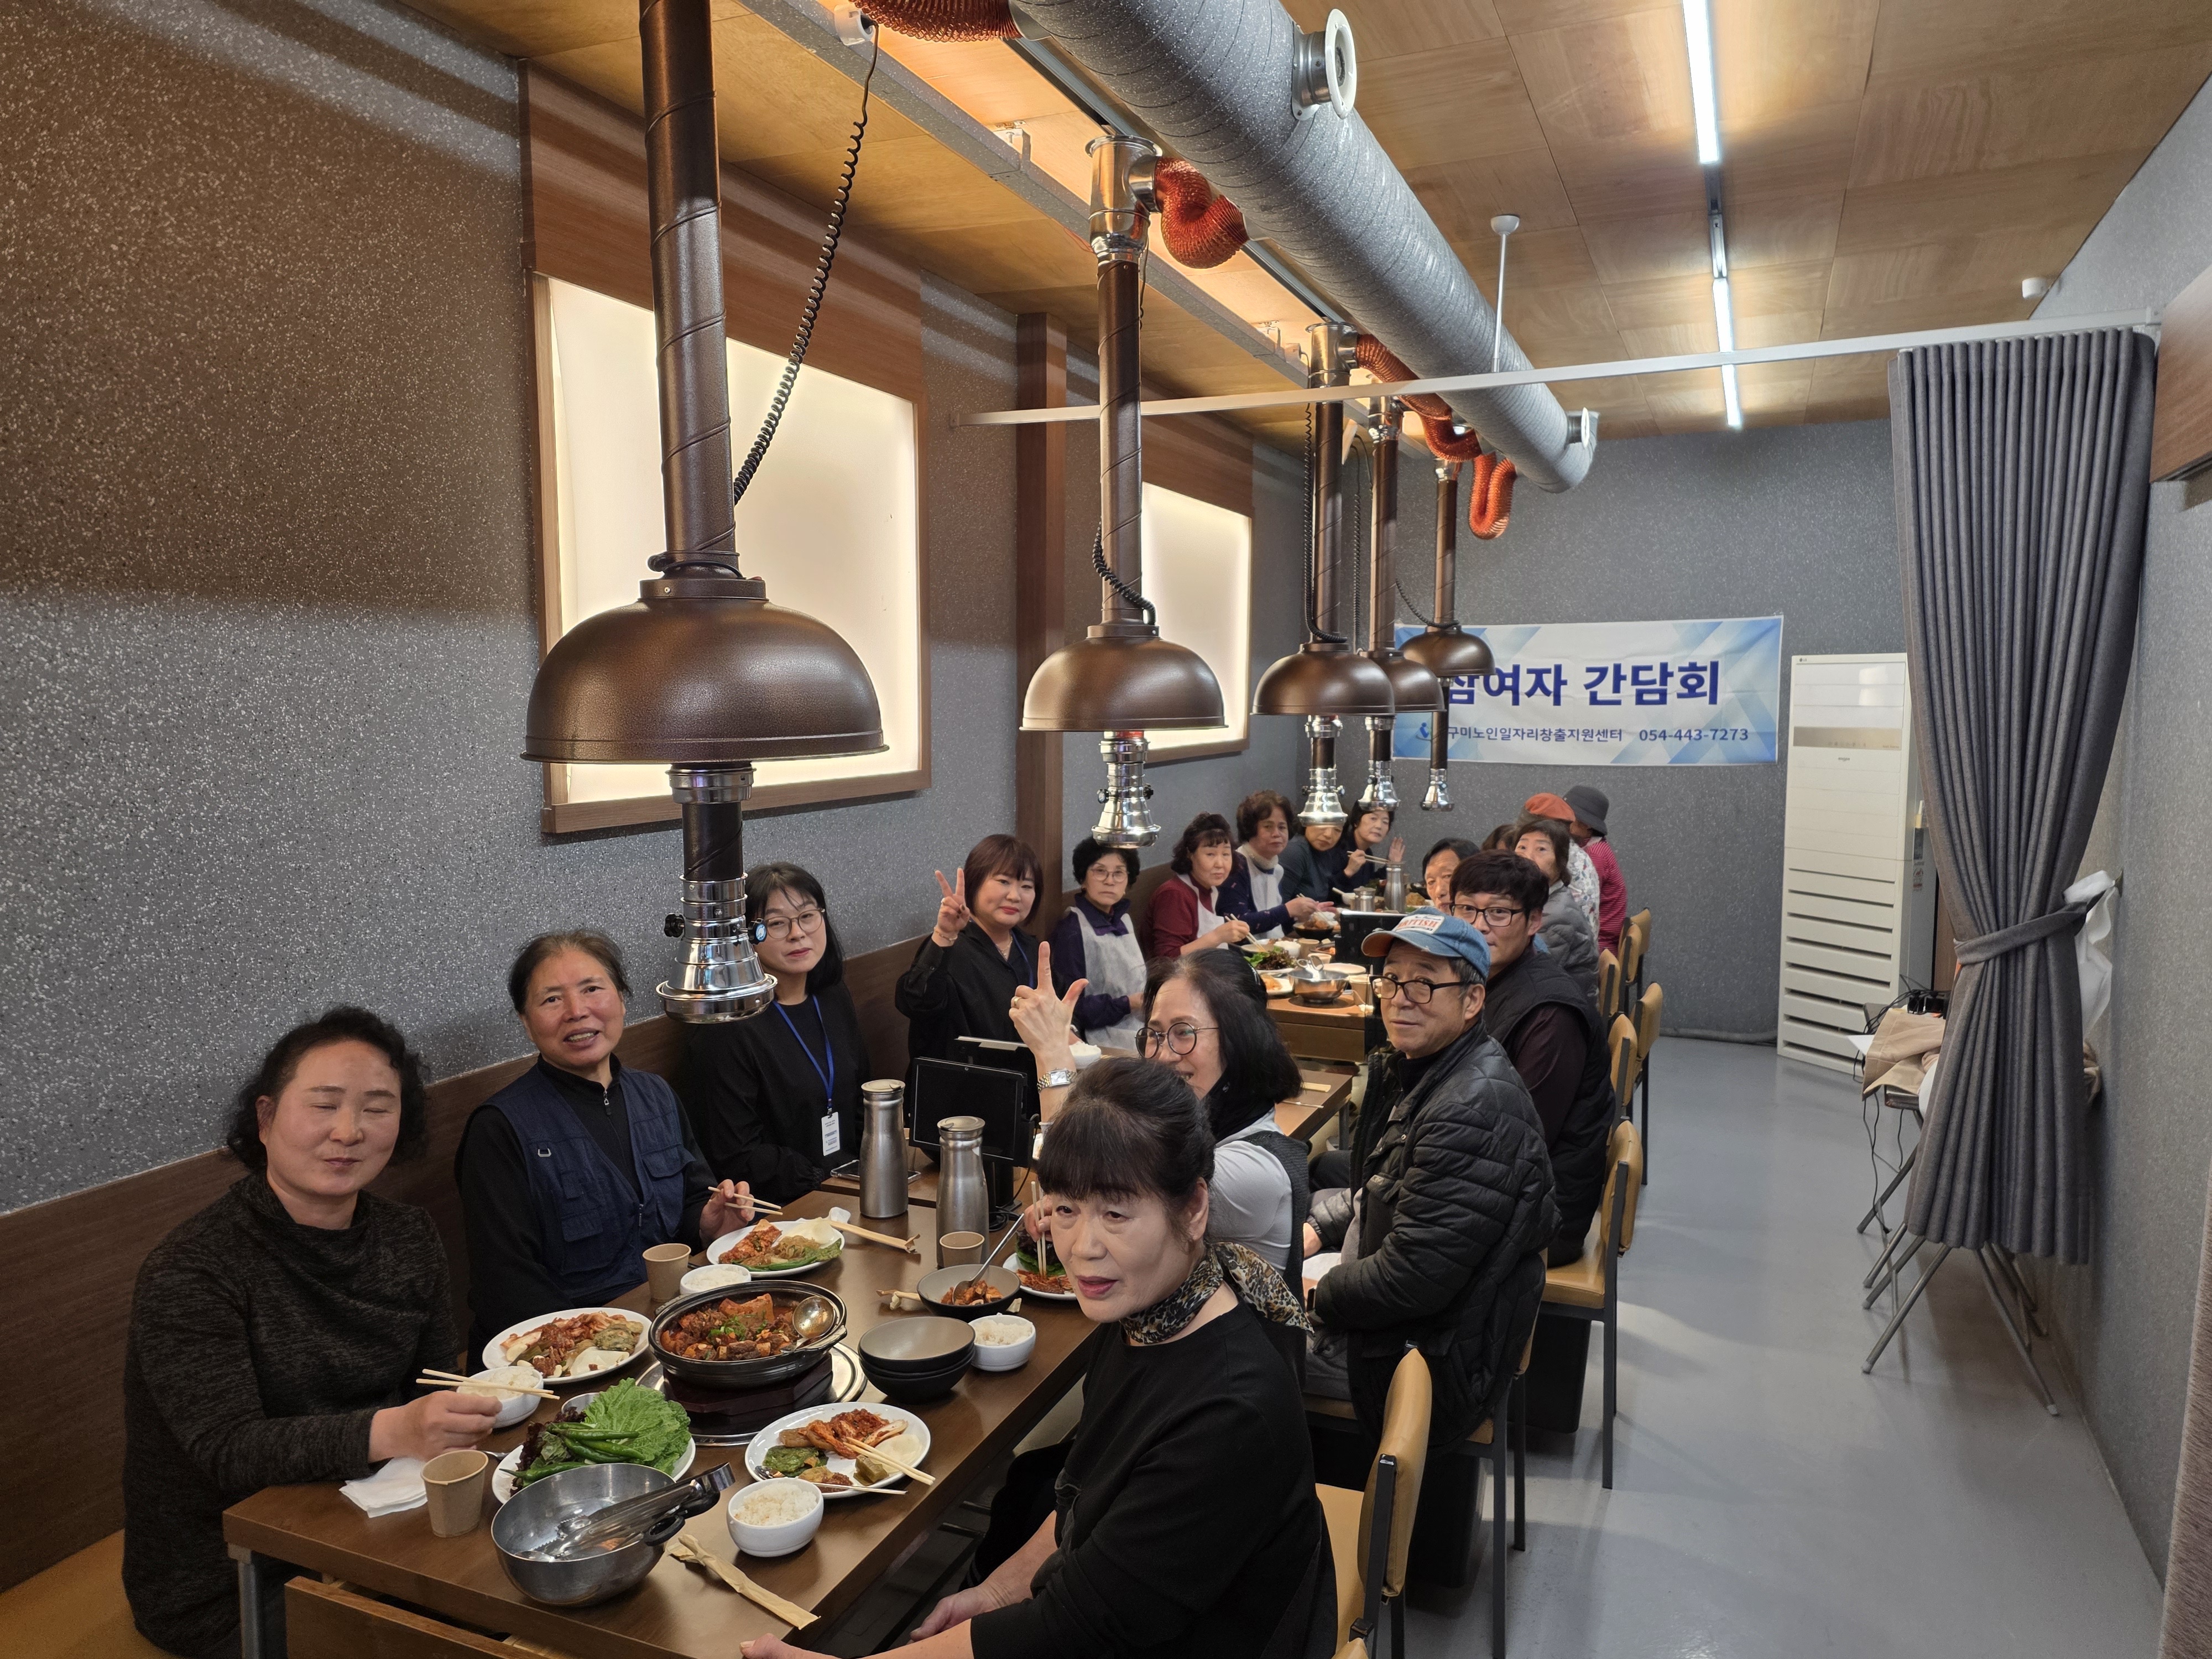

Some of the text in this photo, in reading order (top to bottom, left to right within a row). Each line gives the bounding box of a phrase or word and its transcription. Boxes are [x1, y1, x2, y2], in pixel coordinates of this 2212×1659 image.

[1583, 660, 1719, 706] 간담회
[1448, 726, 1749, 742] 구미노인일자리창출지원센터 054-443-7273
